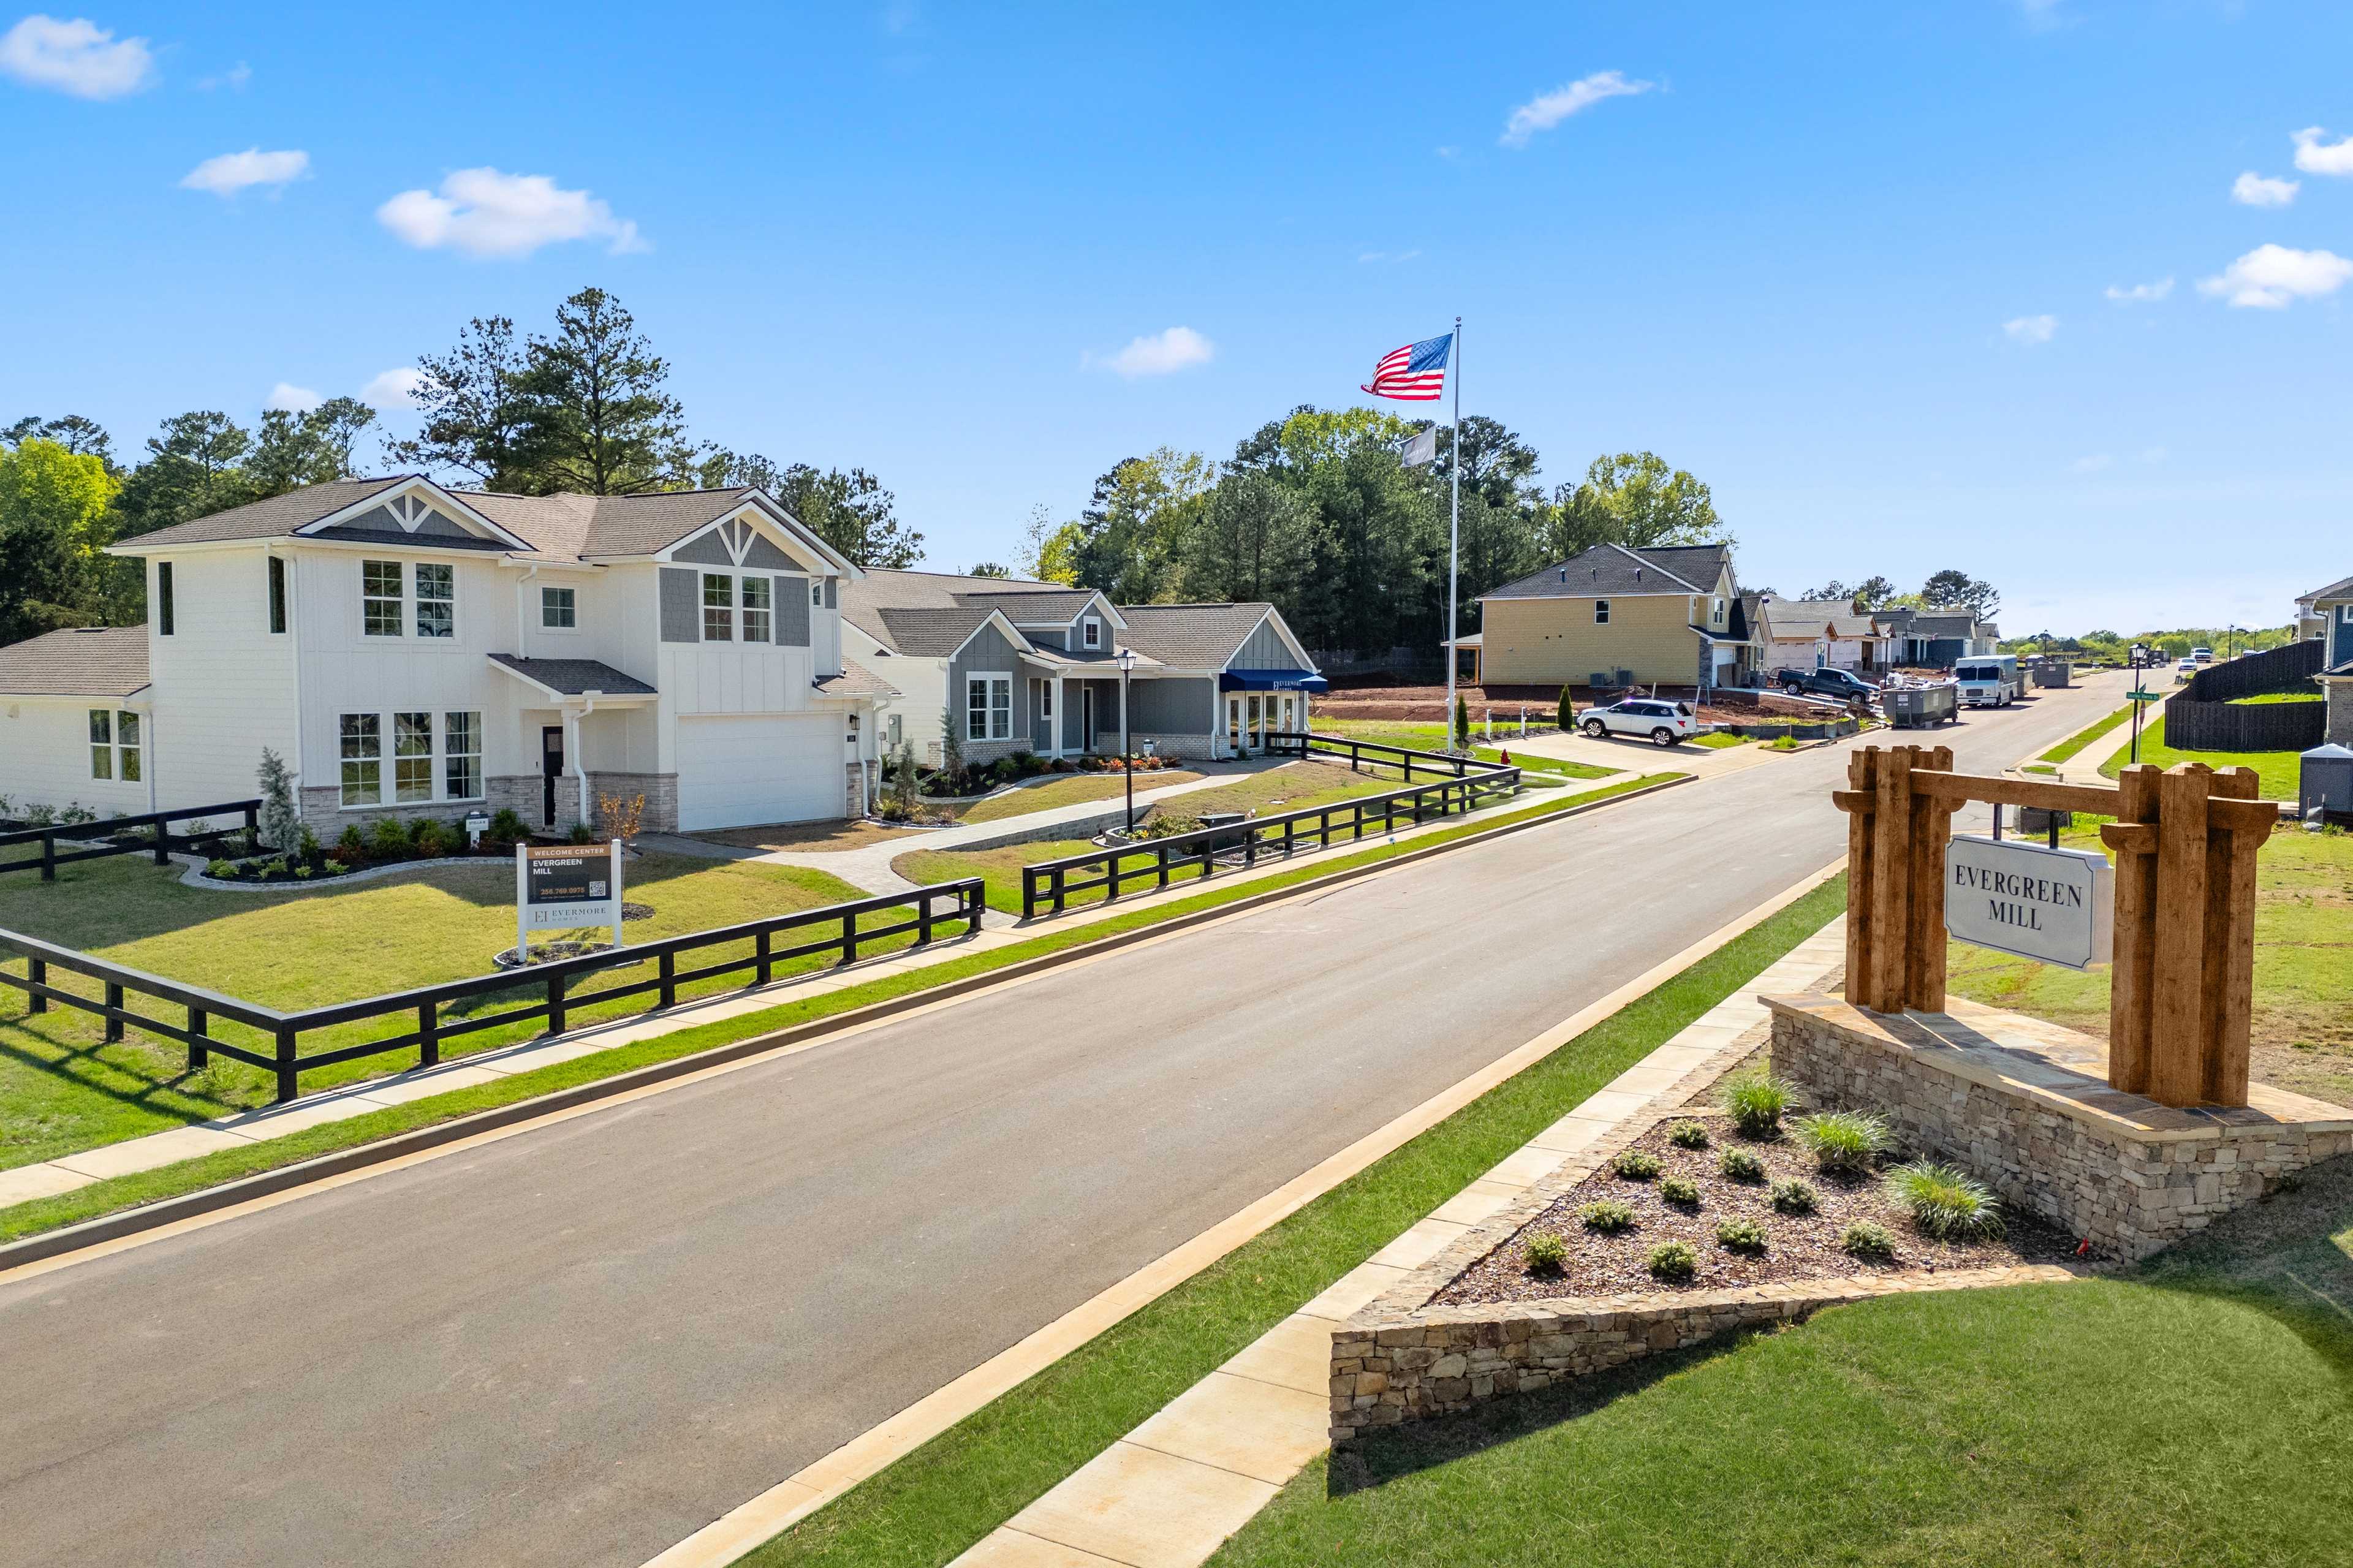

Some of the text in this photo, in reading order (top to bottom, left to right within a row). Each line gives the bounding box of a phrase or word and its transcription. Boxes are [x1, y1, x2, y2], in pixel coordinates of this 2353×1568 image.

[533, 858, 582, 867] EVERGREEN
[1955, 865, 2083, 908] EVERGREEN
[552, 907, 606, 917] EVERMORE
[1988, 900, 2042, 931] MILL
